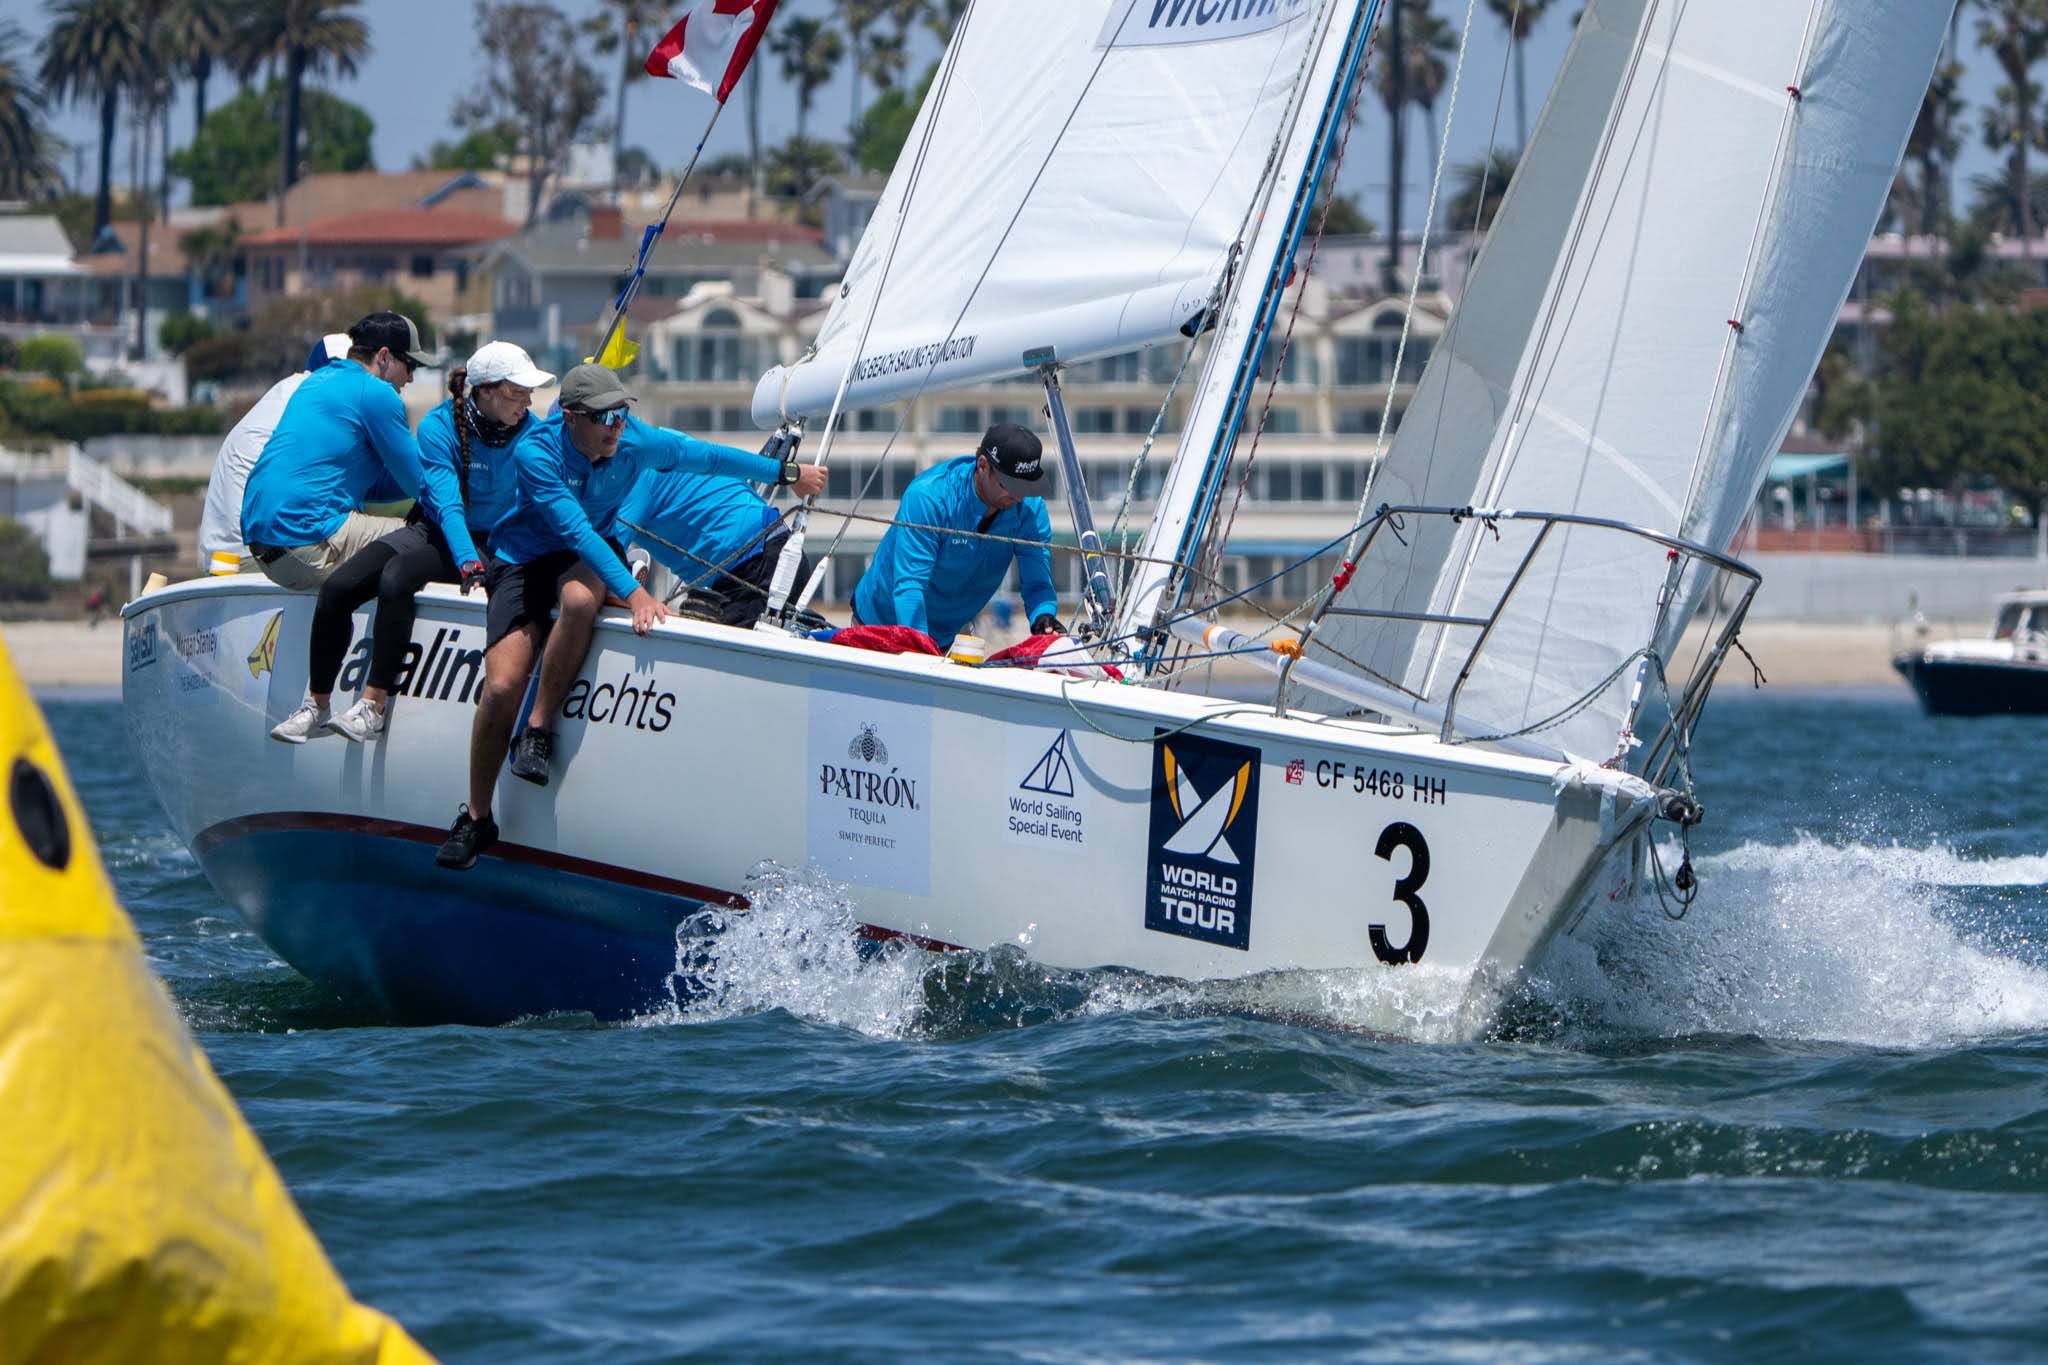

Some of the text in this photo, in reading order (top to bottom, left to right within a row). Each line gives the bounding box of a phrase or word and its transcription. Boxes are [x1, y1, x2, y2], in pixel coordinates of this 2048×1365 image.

[867, 352, 898, 379] BEACH
[895, 344, 929, 372] SAILING
[196, 626, 218, 661] Stanley
[562, 673, 676, 732] achts
[1316, 759, 1446, 805] CF 5468 HH
[849, 807, 886, 825] TEQUILA
[1009, 796, 1082, 826] World Sailing
[1008, 816, 1083, 843] Special Event
[1161, 884, 1236, 909] MATCH RACING
[1162, 863, 1238, 896] WORLD
[1368, 821, 1431, 966] 3
[1160, 895, 1236, 934] TOUR
